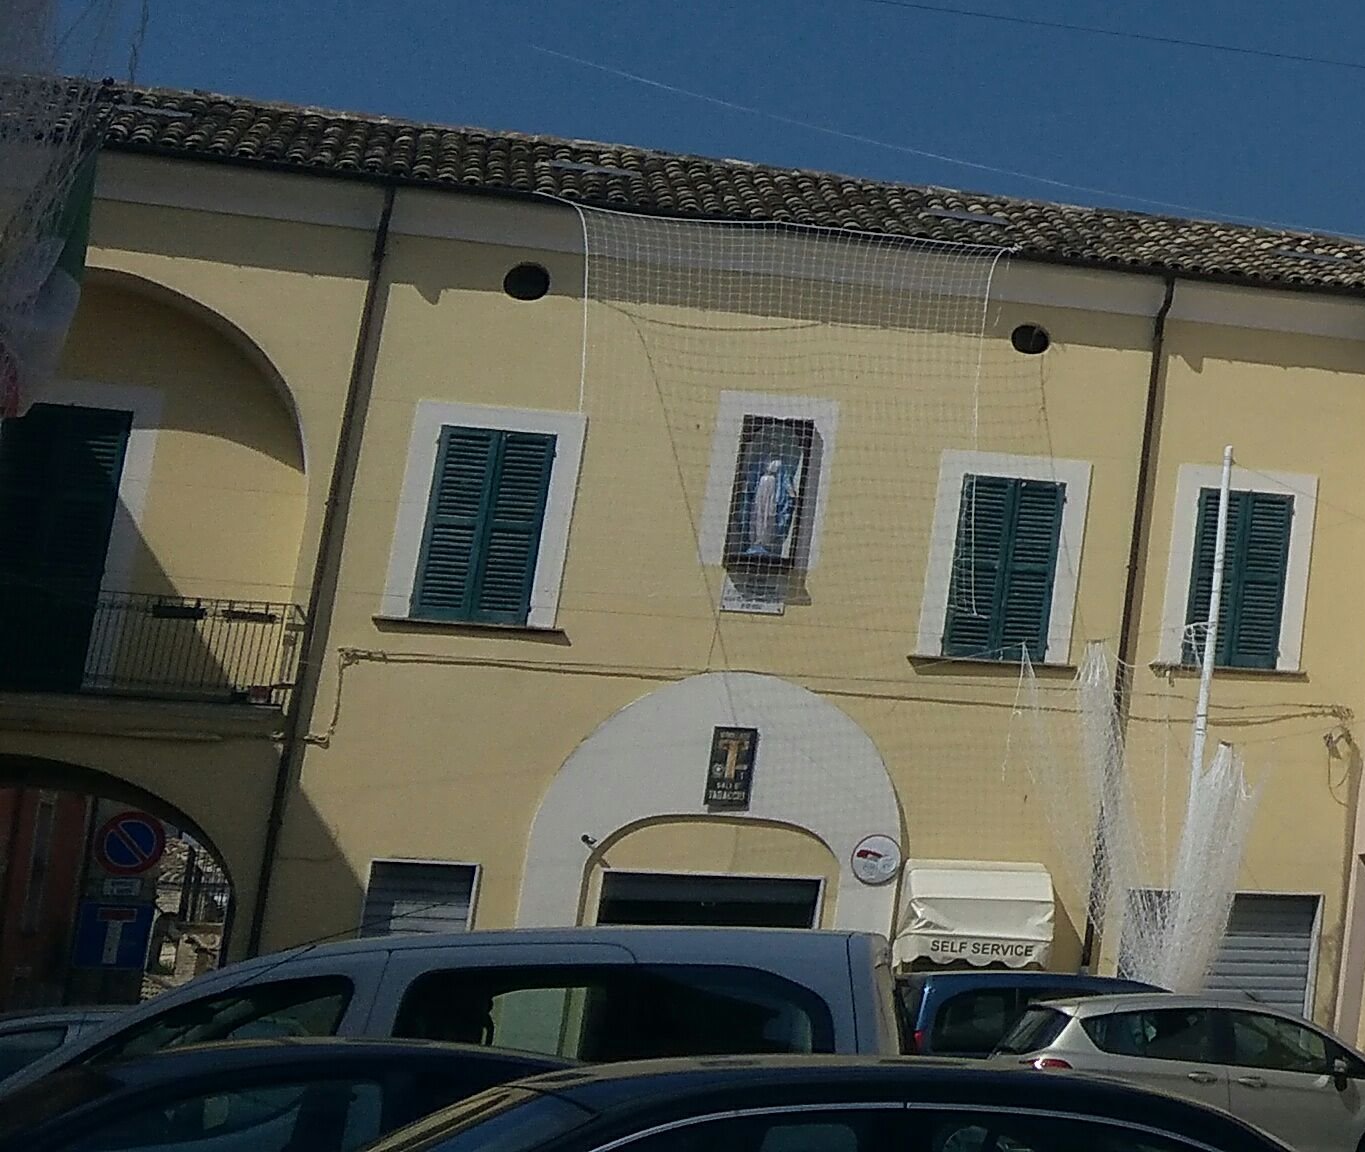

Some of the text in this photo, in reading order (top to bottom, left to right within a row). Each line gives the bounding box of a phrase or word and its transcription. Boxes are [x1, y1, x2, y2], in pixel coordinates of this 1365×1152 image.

[708, 791, 746, 801] TABACCHI
[930, 940, 1035, 957] SELF SERVICE
